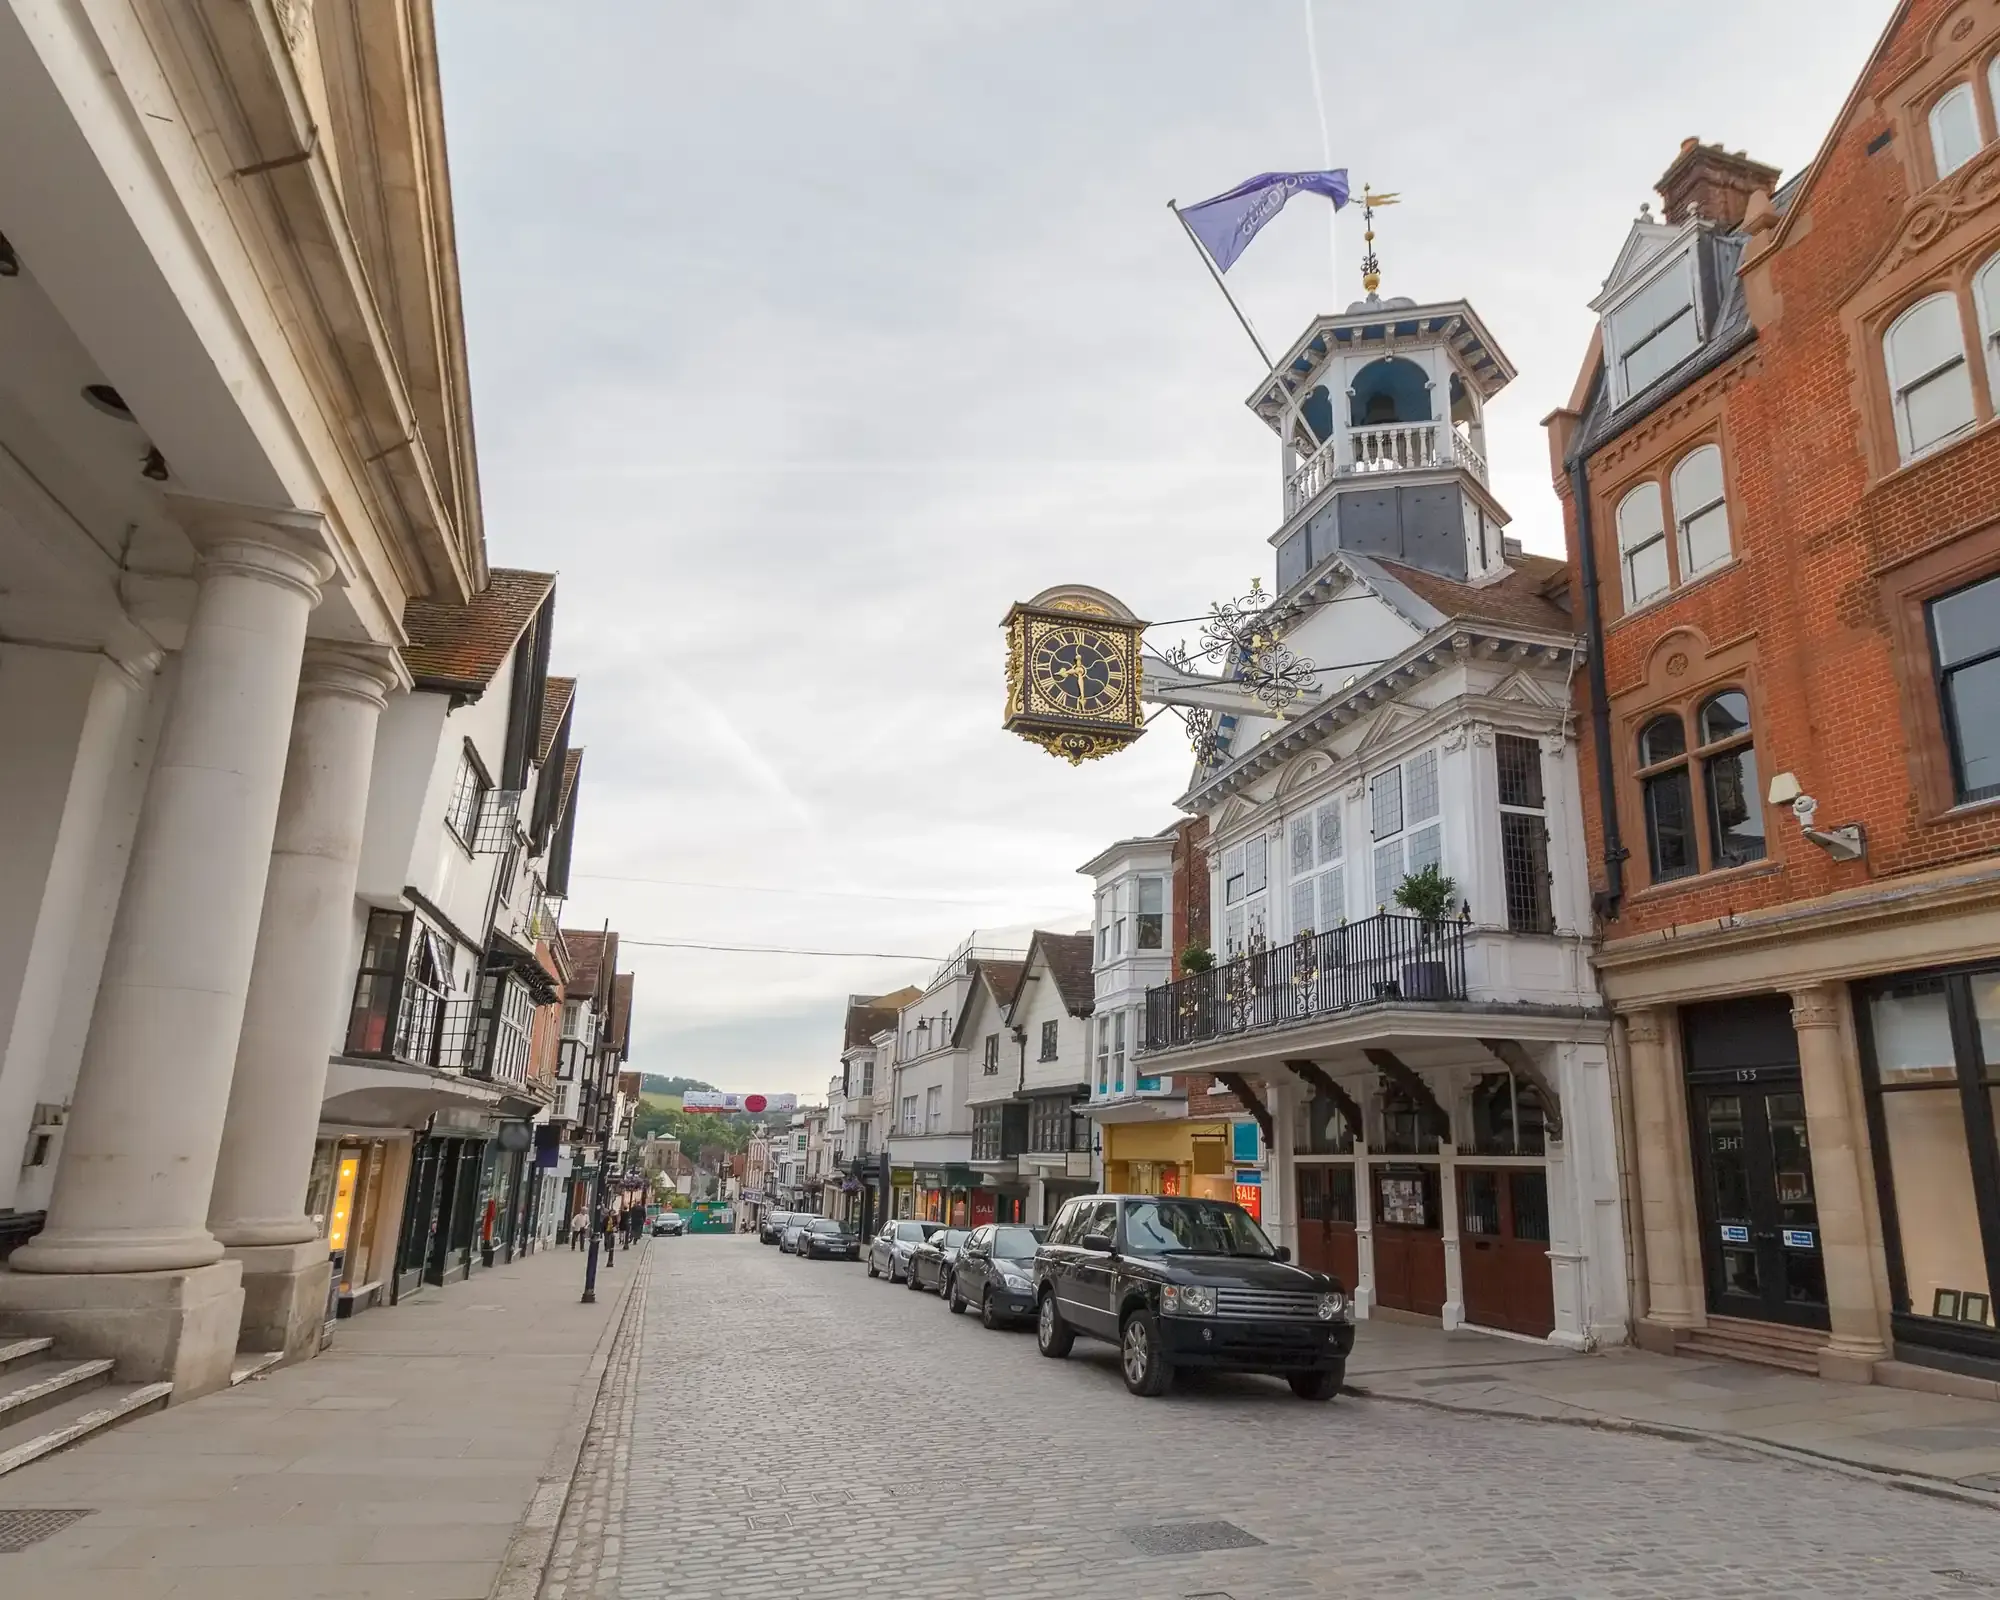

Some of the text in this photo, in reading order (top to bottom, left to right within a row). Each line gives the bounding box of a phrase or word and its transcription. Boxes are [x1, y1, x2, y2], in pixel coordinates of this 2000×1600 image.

[1736, 1069, 1757, 1081] 133
[1236, 1186, 1257, 1200] SALE
[976, 1205, 994, 1213] SAL
